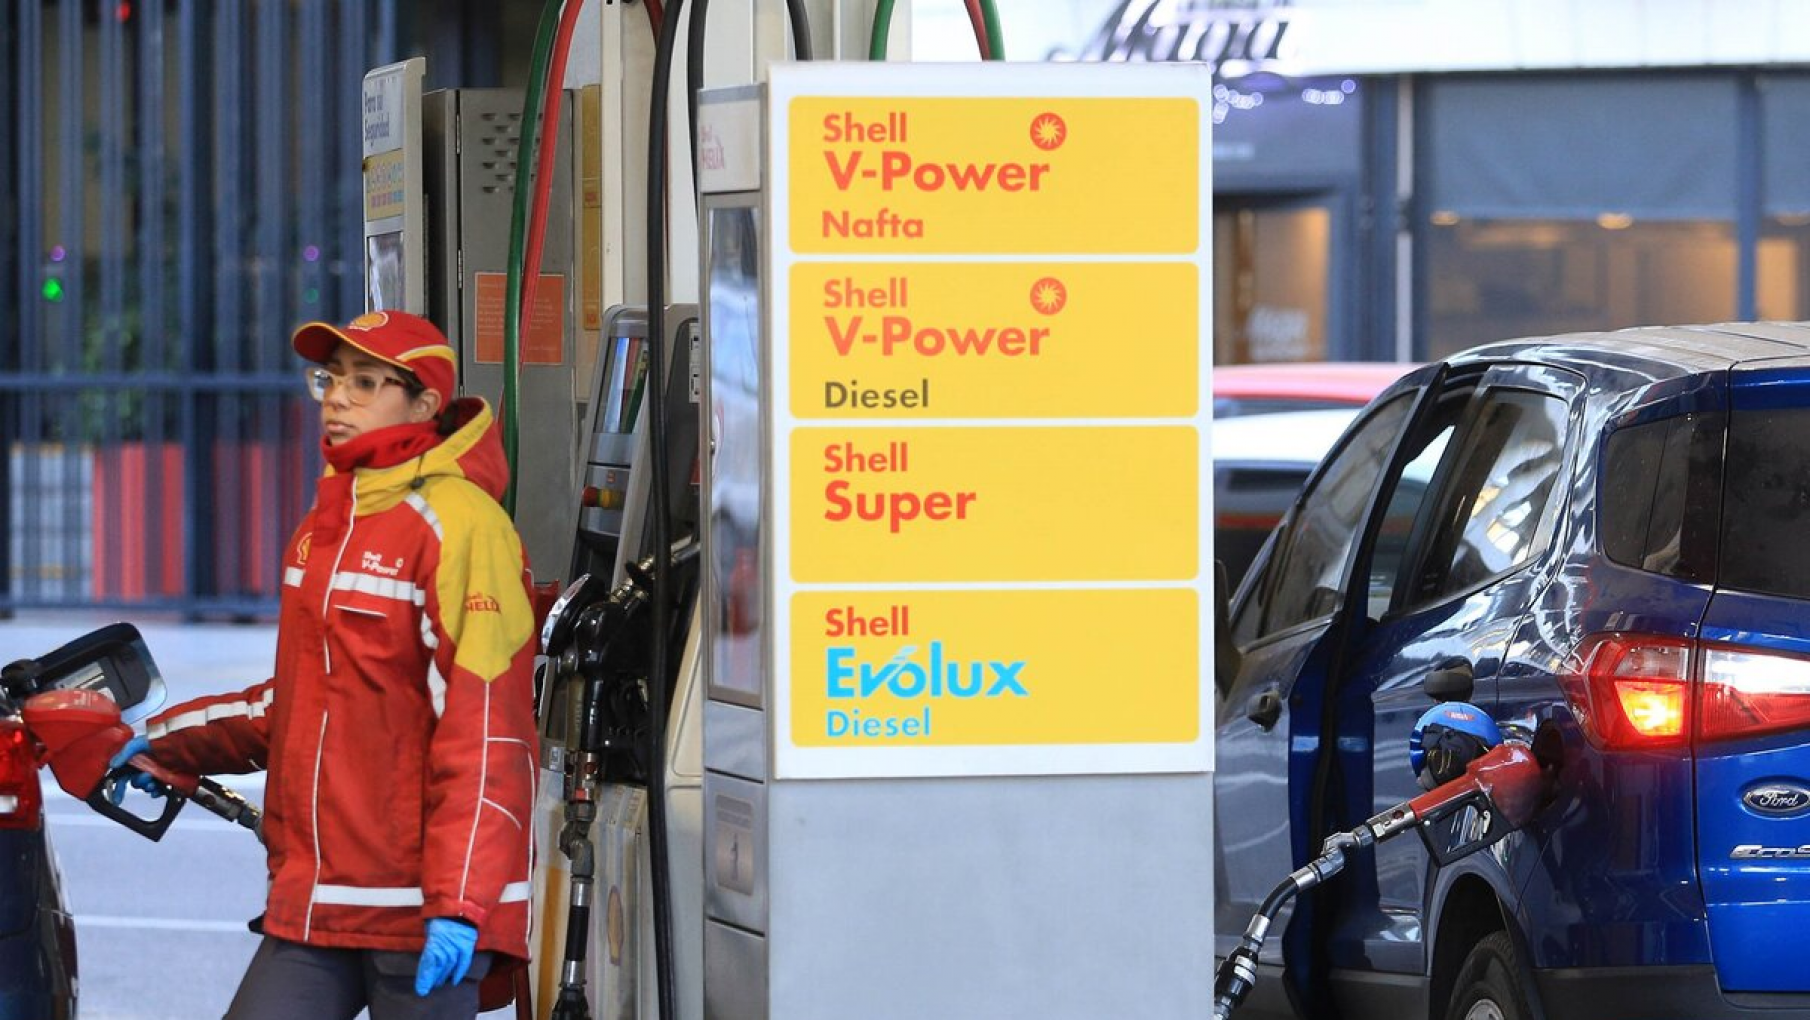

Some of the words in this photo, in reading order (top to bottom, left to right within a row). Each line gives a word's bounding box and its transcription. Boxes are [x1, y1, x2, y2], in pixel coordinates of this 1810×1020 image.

[823, 113, 906, 143] Shell
[824, 152, 1050, 191] V-Power
[823, 208, 923, 238] Nafta
[823, 277, 908, 309] Shell
[824, 315, 1050, 357] V-Power
[824, 378, 929, 409] Diesel
[824, 441, 908, 473] Shell
[824, 480, 977, 533] Super
[825, 605, 909, 637] Shell
[826, 705, 931, 738] Diesel
[1759, 789, 1799, 807] Ford
